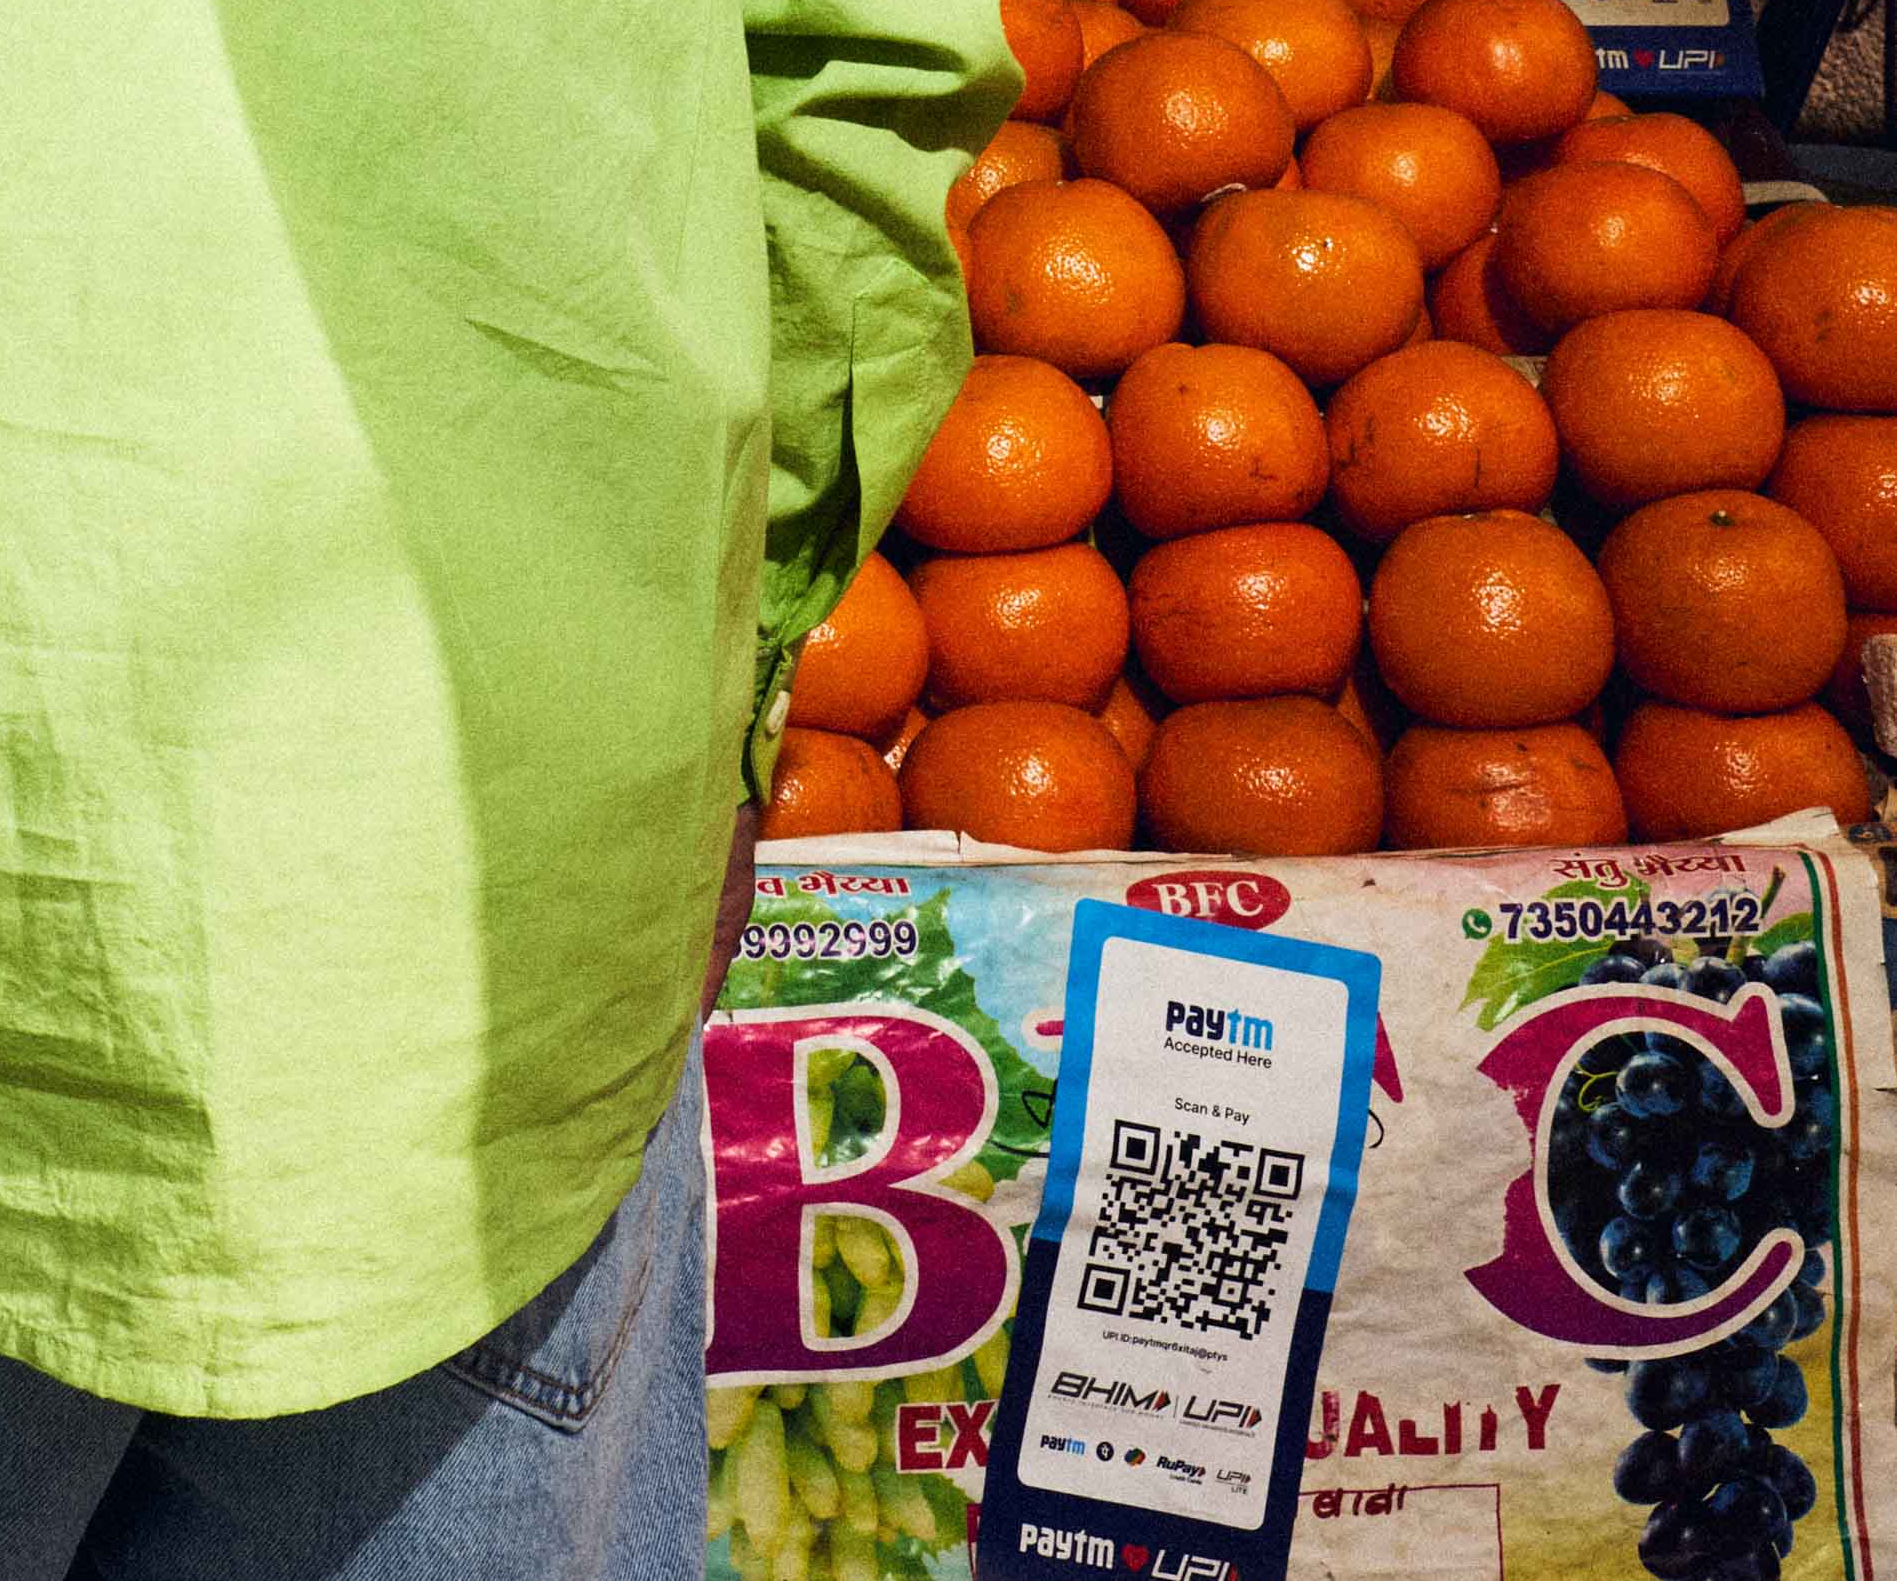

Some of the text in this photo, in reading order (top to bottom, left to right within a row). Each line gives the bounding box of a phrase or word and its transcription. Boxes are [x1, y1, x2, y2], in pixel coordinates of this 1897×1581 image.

[1659, 49, 1716, 70] UPI
[1152, 879, 1264, 918] BFC
[1499, 897, 1760, 940] 7350443212
[1165, 1000, 1274, 1051] paytm
[1164, 1037, 1273, 1069] Accepted Here
[1174, 1097, 1251, 1126] Scan & Pay
[1102, 1331, 1120, 1342] UPI
[1051, 1371, 1159, 1411] BHIM
[1182, 1395, 1252, 1428] UPI
[1040, 1434, 1245, 1483] paytm RuPay UPI
[1018, 1522, 1231, 1581] paytm UPI
